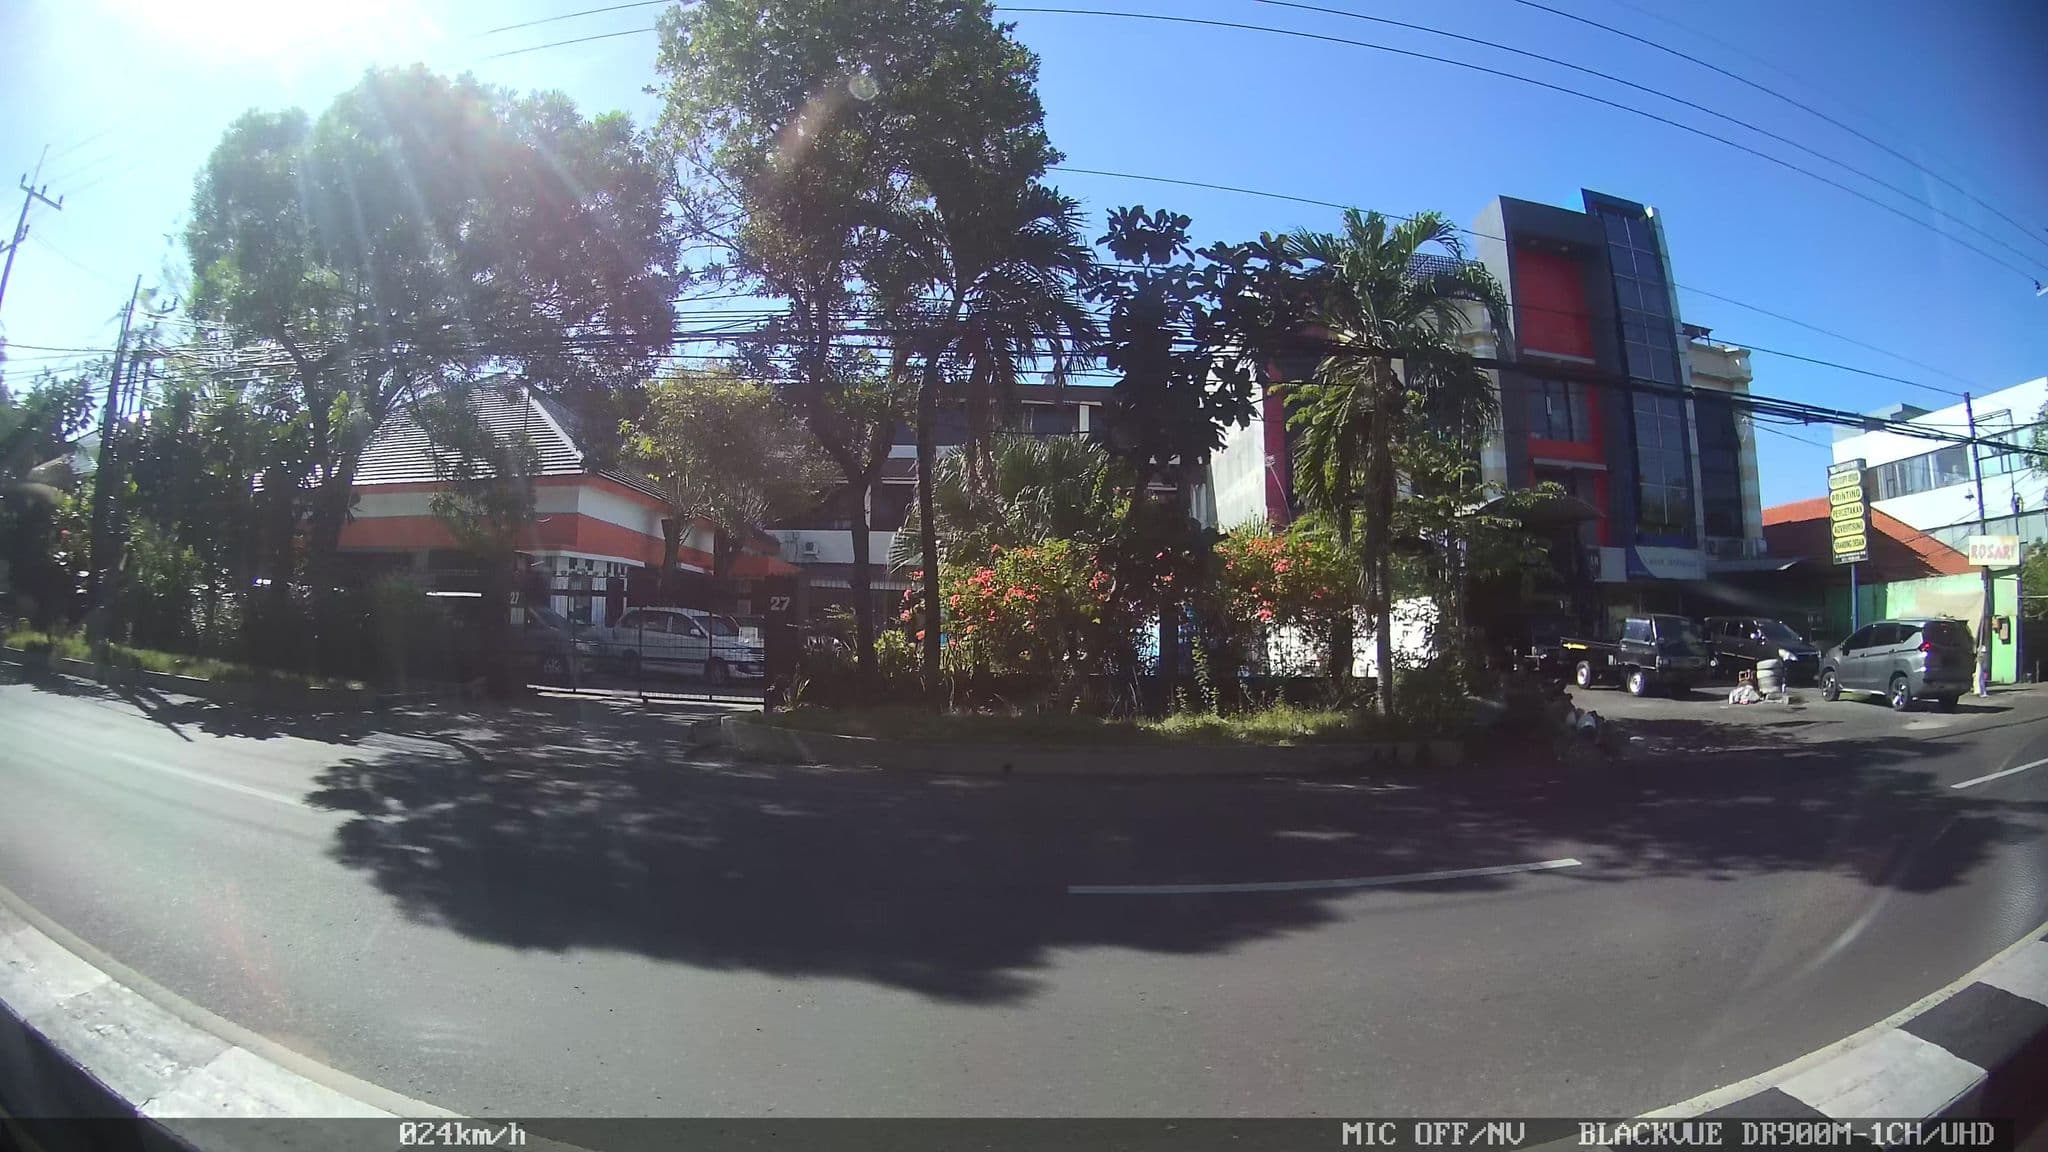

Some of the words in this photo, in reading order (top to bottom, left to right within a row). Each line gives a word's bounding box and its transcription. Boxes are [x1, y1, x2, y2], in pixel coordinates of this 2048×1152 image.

[1832, 488, 1860, 501] PRINTING
[1833, 505, 1862, 518] PERCETAKAN
[510, 591, 520, 604] 27
[770, 596, 790, 611] 27
